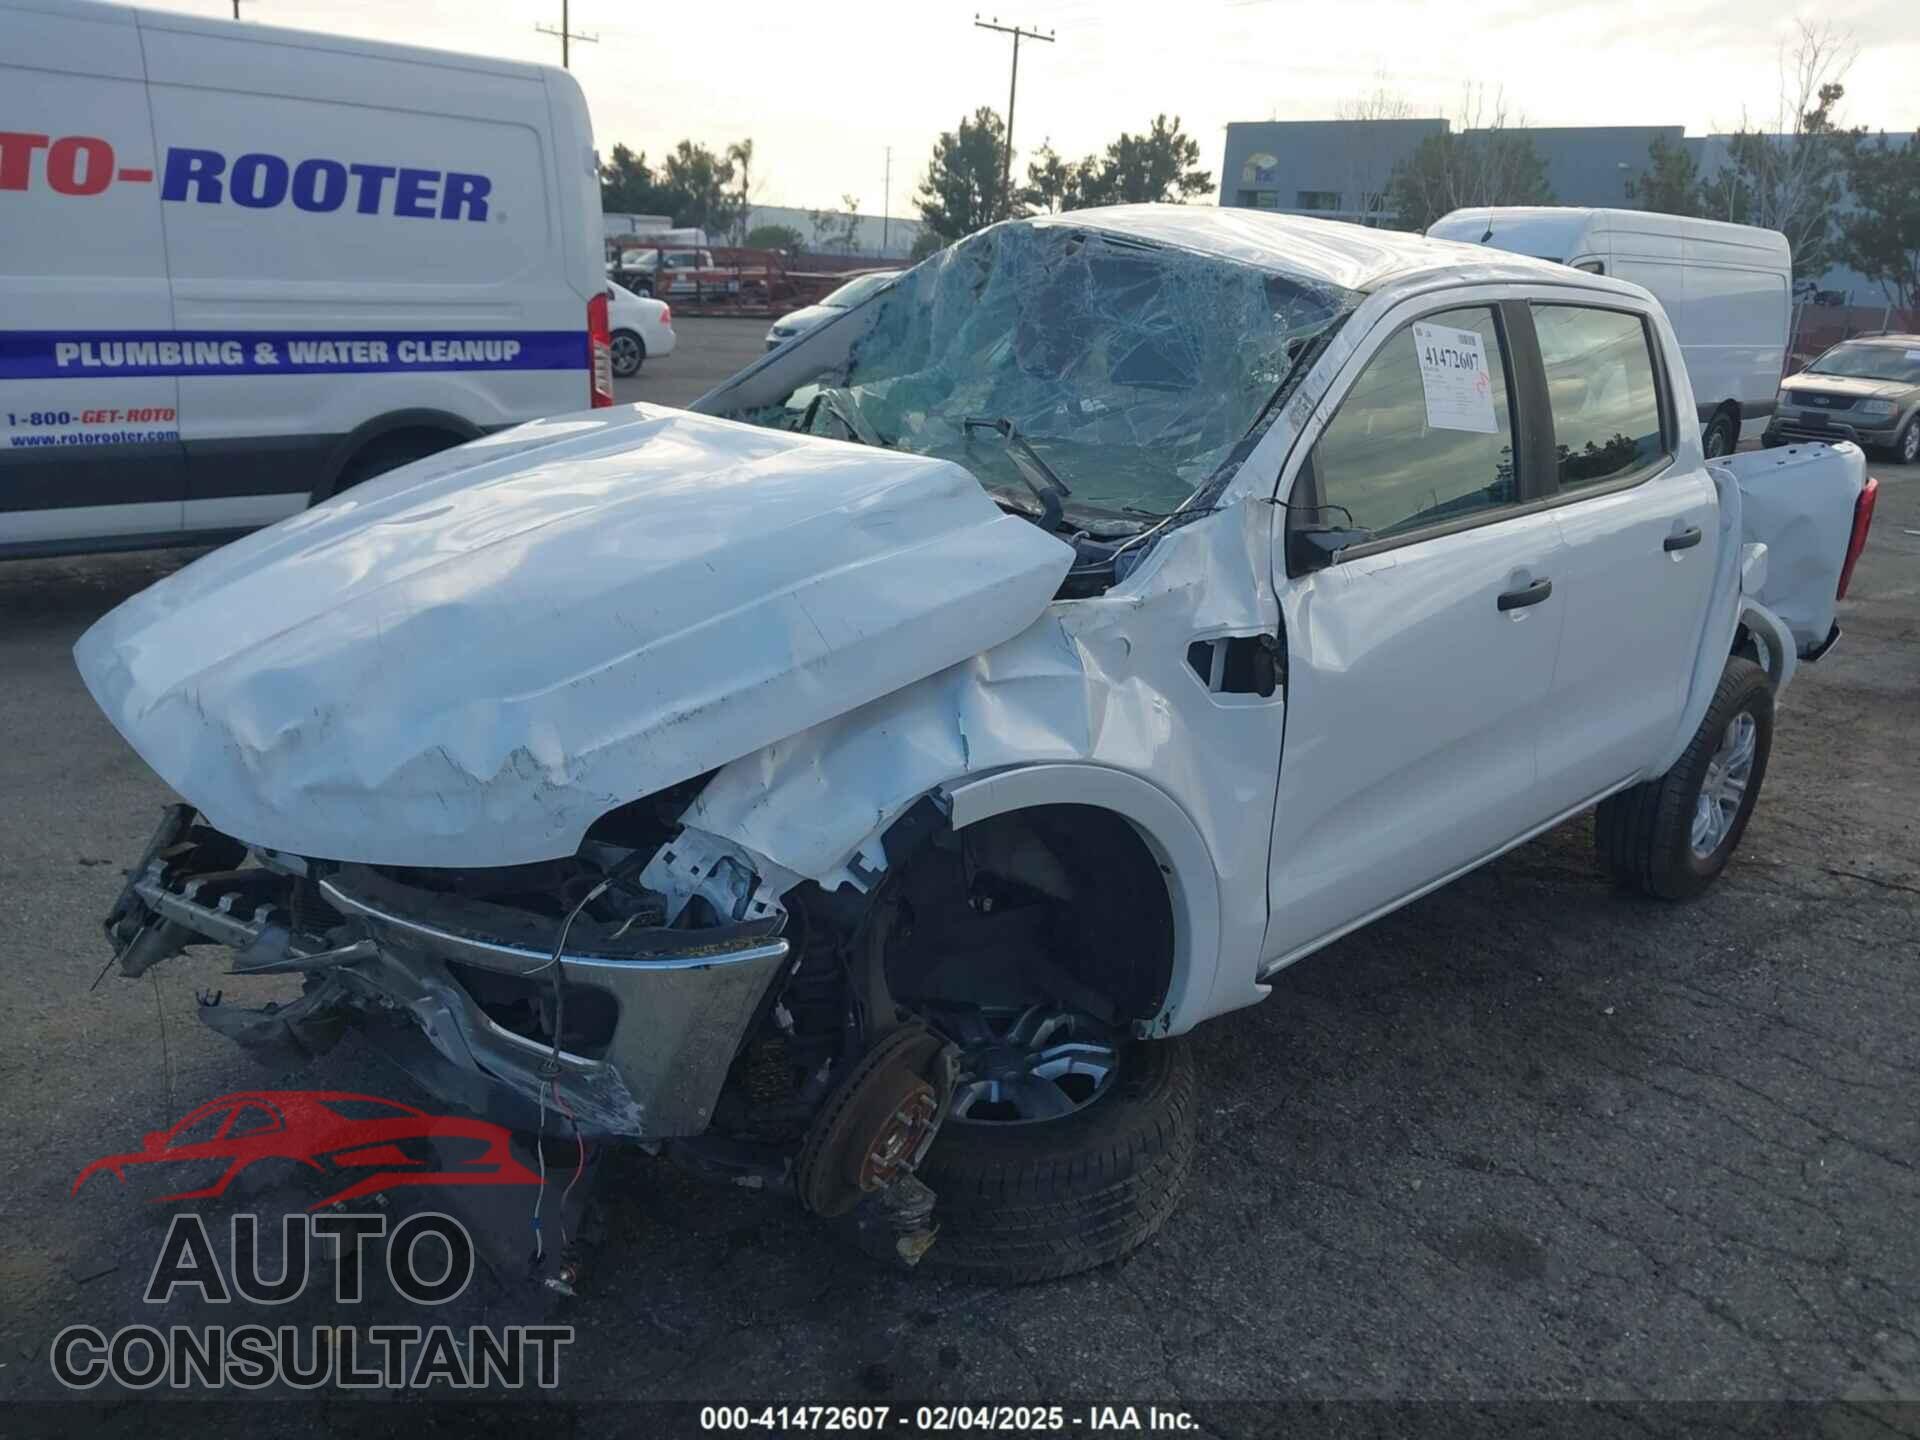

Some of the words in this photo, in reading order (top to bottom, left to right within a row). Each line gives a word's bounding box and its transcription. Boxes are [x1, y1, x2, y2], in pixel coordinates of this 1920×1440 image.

[55, 341, 244, 367] PLUMBING
[253, 341, 279, 366] &
[287, 341, 389, 365] WATER
[398, 340, 522, 363] CLEANUP
[1425, 346, 1478, 370] 41472607
[8, 408, 176, 426] 1-800-GET-ROTO
[10, 430, 180, 447] www.rotorooter.com
